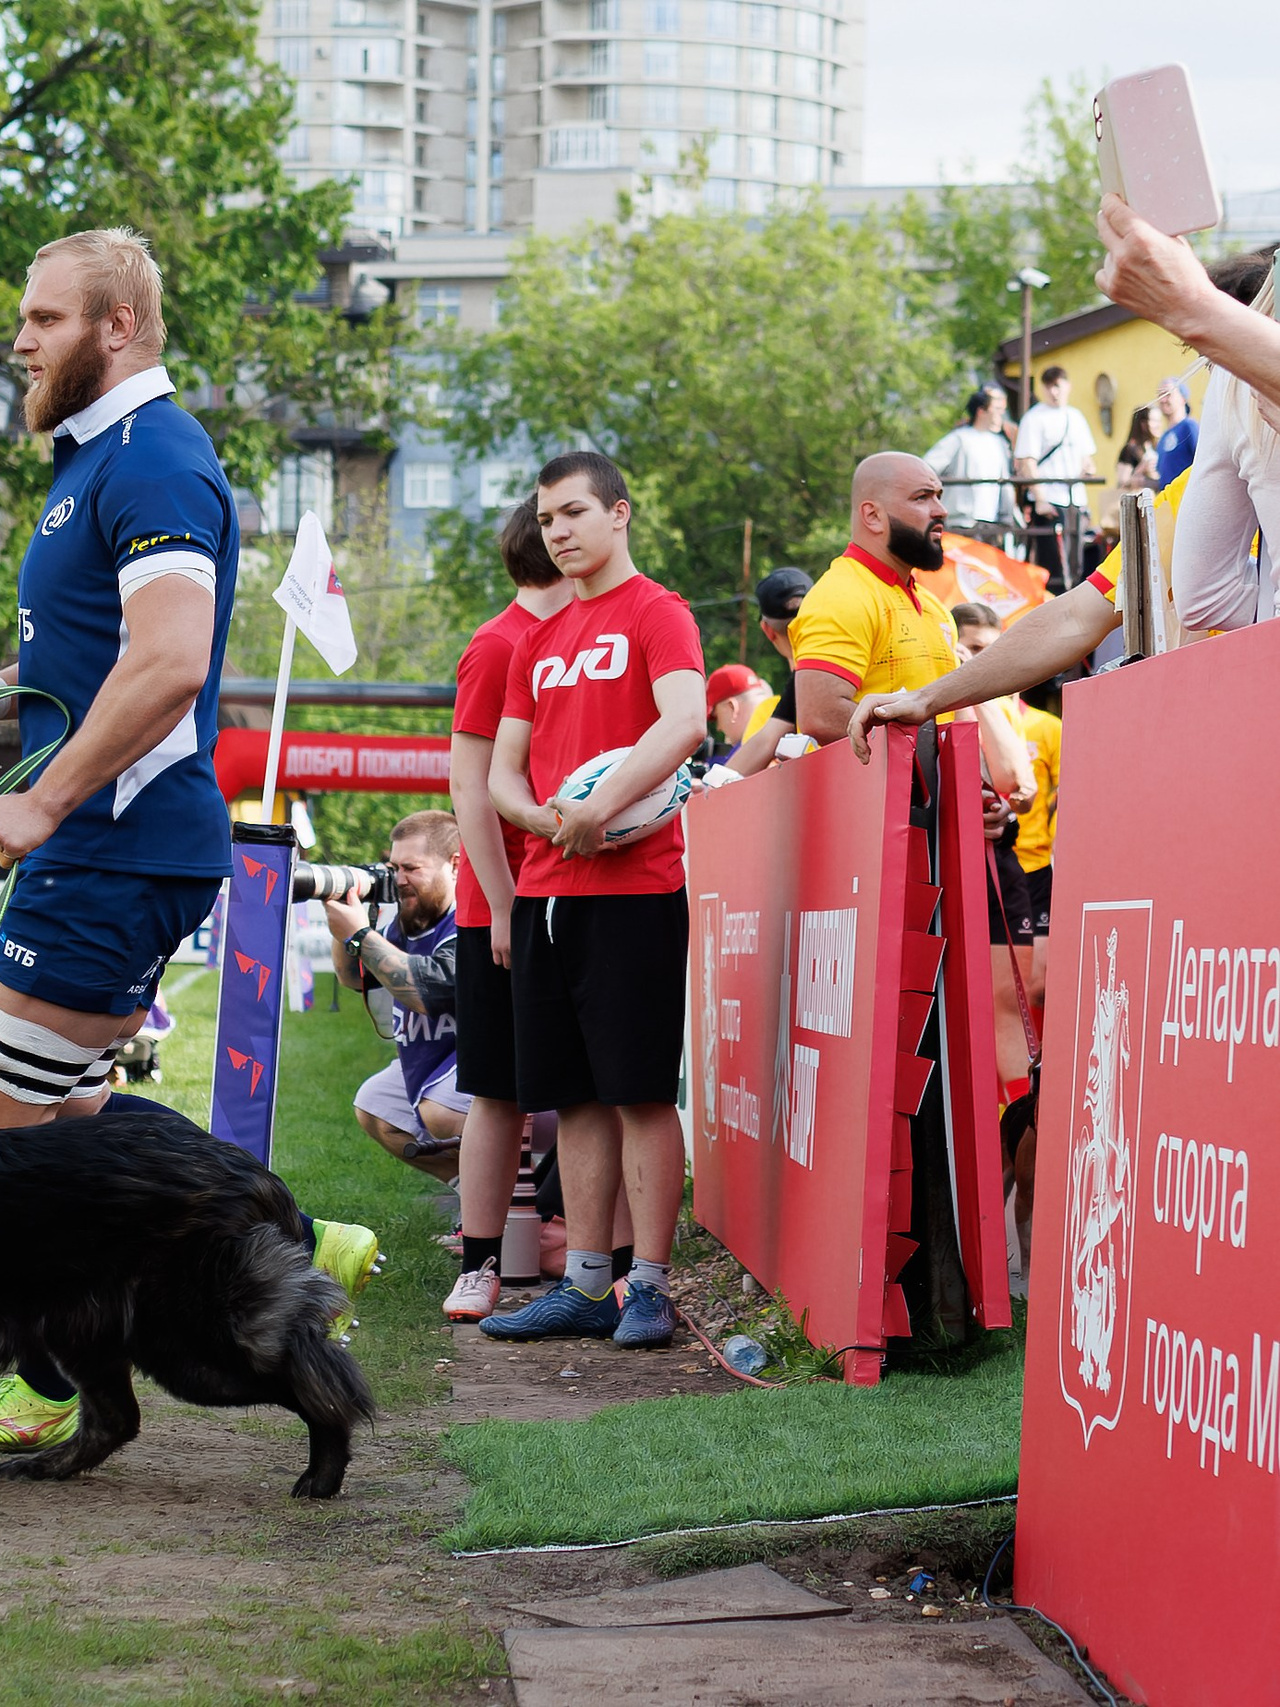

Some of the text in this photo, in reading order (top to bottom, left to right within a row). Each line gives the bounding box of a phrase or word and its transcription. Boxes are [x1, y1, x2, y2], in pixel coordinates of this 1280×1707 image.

[285, 745, 354, 778] ДОБРО
[3, 939, 38, 968] ВТБ
[1159, 919, 1280, 1083] Департа
[789, 1043, 820, 1171] СПОРТ
[1153, 1132, 1249, 1275] спорта
[1142, 1317, 1280, 1477] города М
